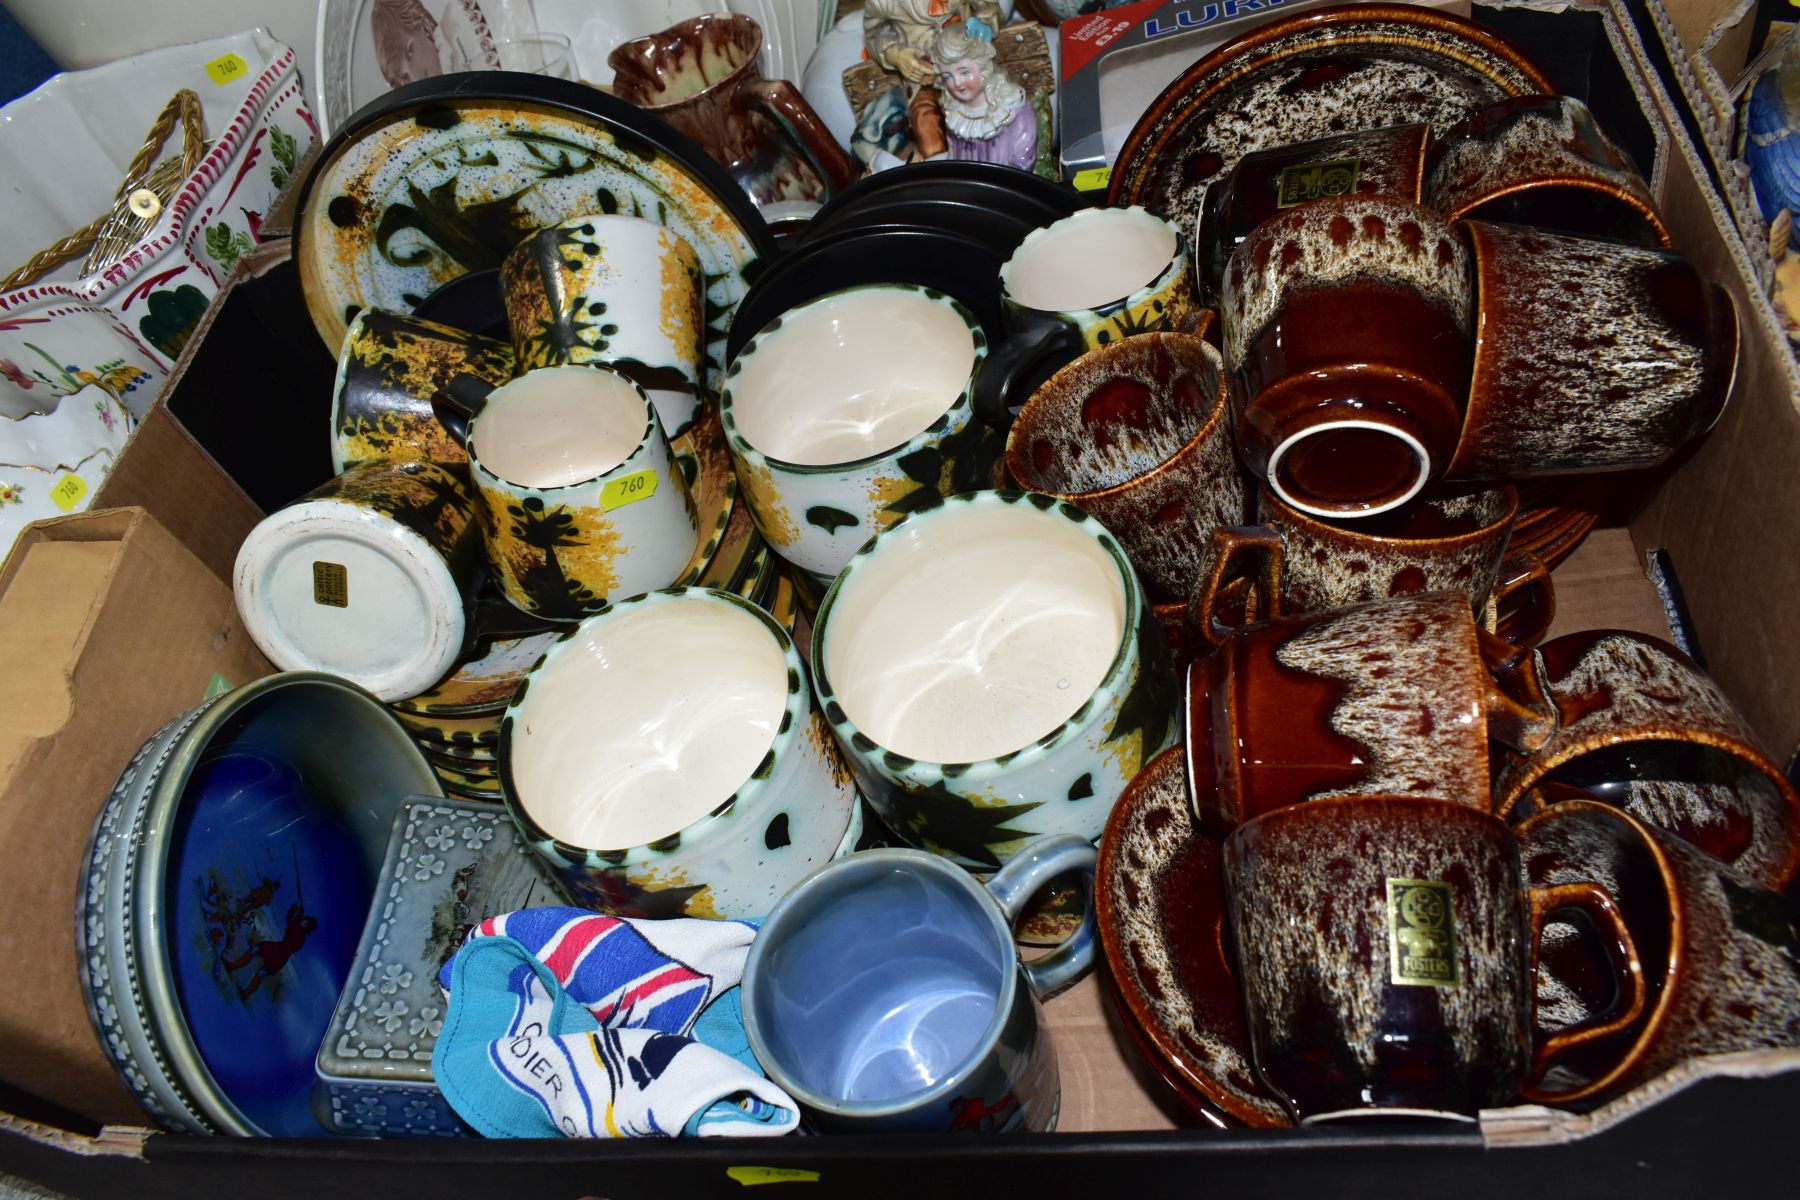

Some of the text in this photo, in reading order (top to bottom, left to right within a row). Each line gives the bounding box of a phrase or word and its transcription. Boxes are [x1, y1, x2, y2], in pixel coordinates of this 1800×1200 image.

[217, 59, 238, 76] 760
[60, 480, 80, 500] 760
[620, 476, 645, 496] 760
